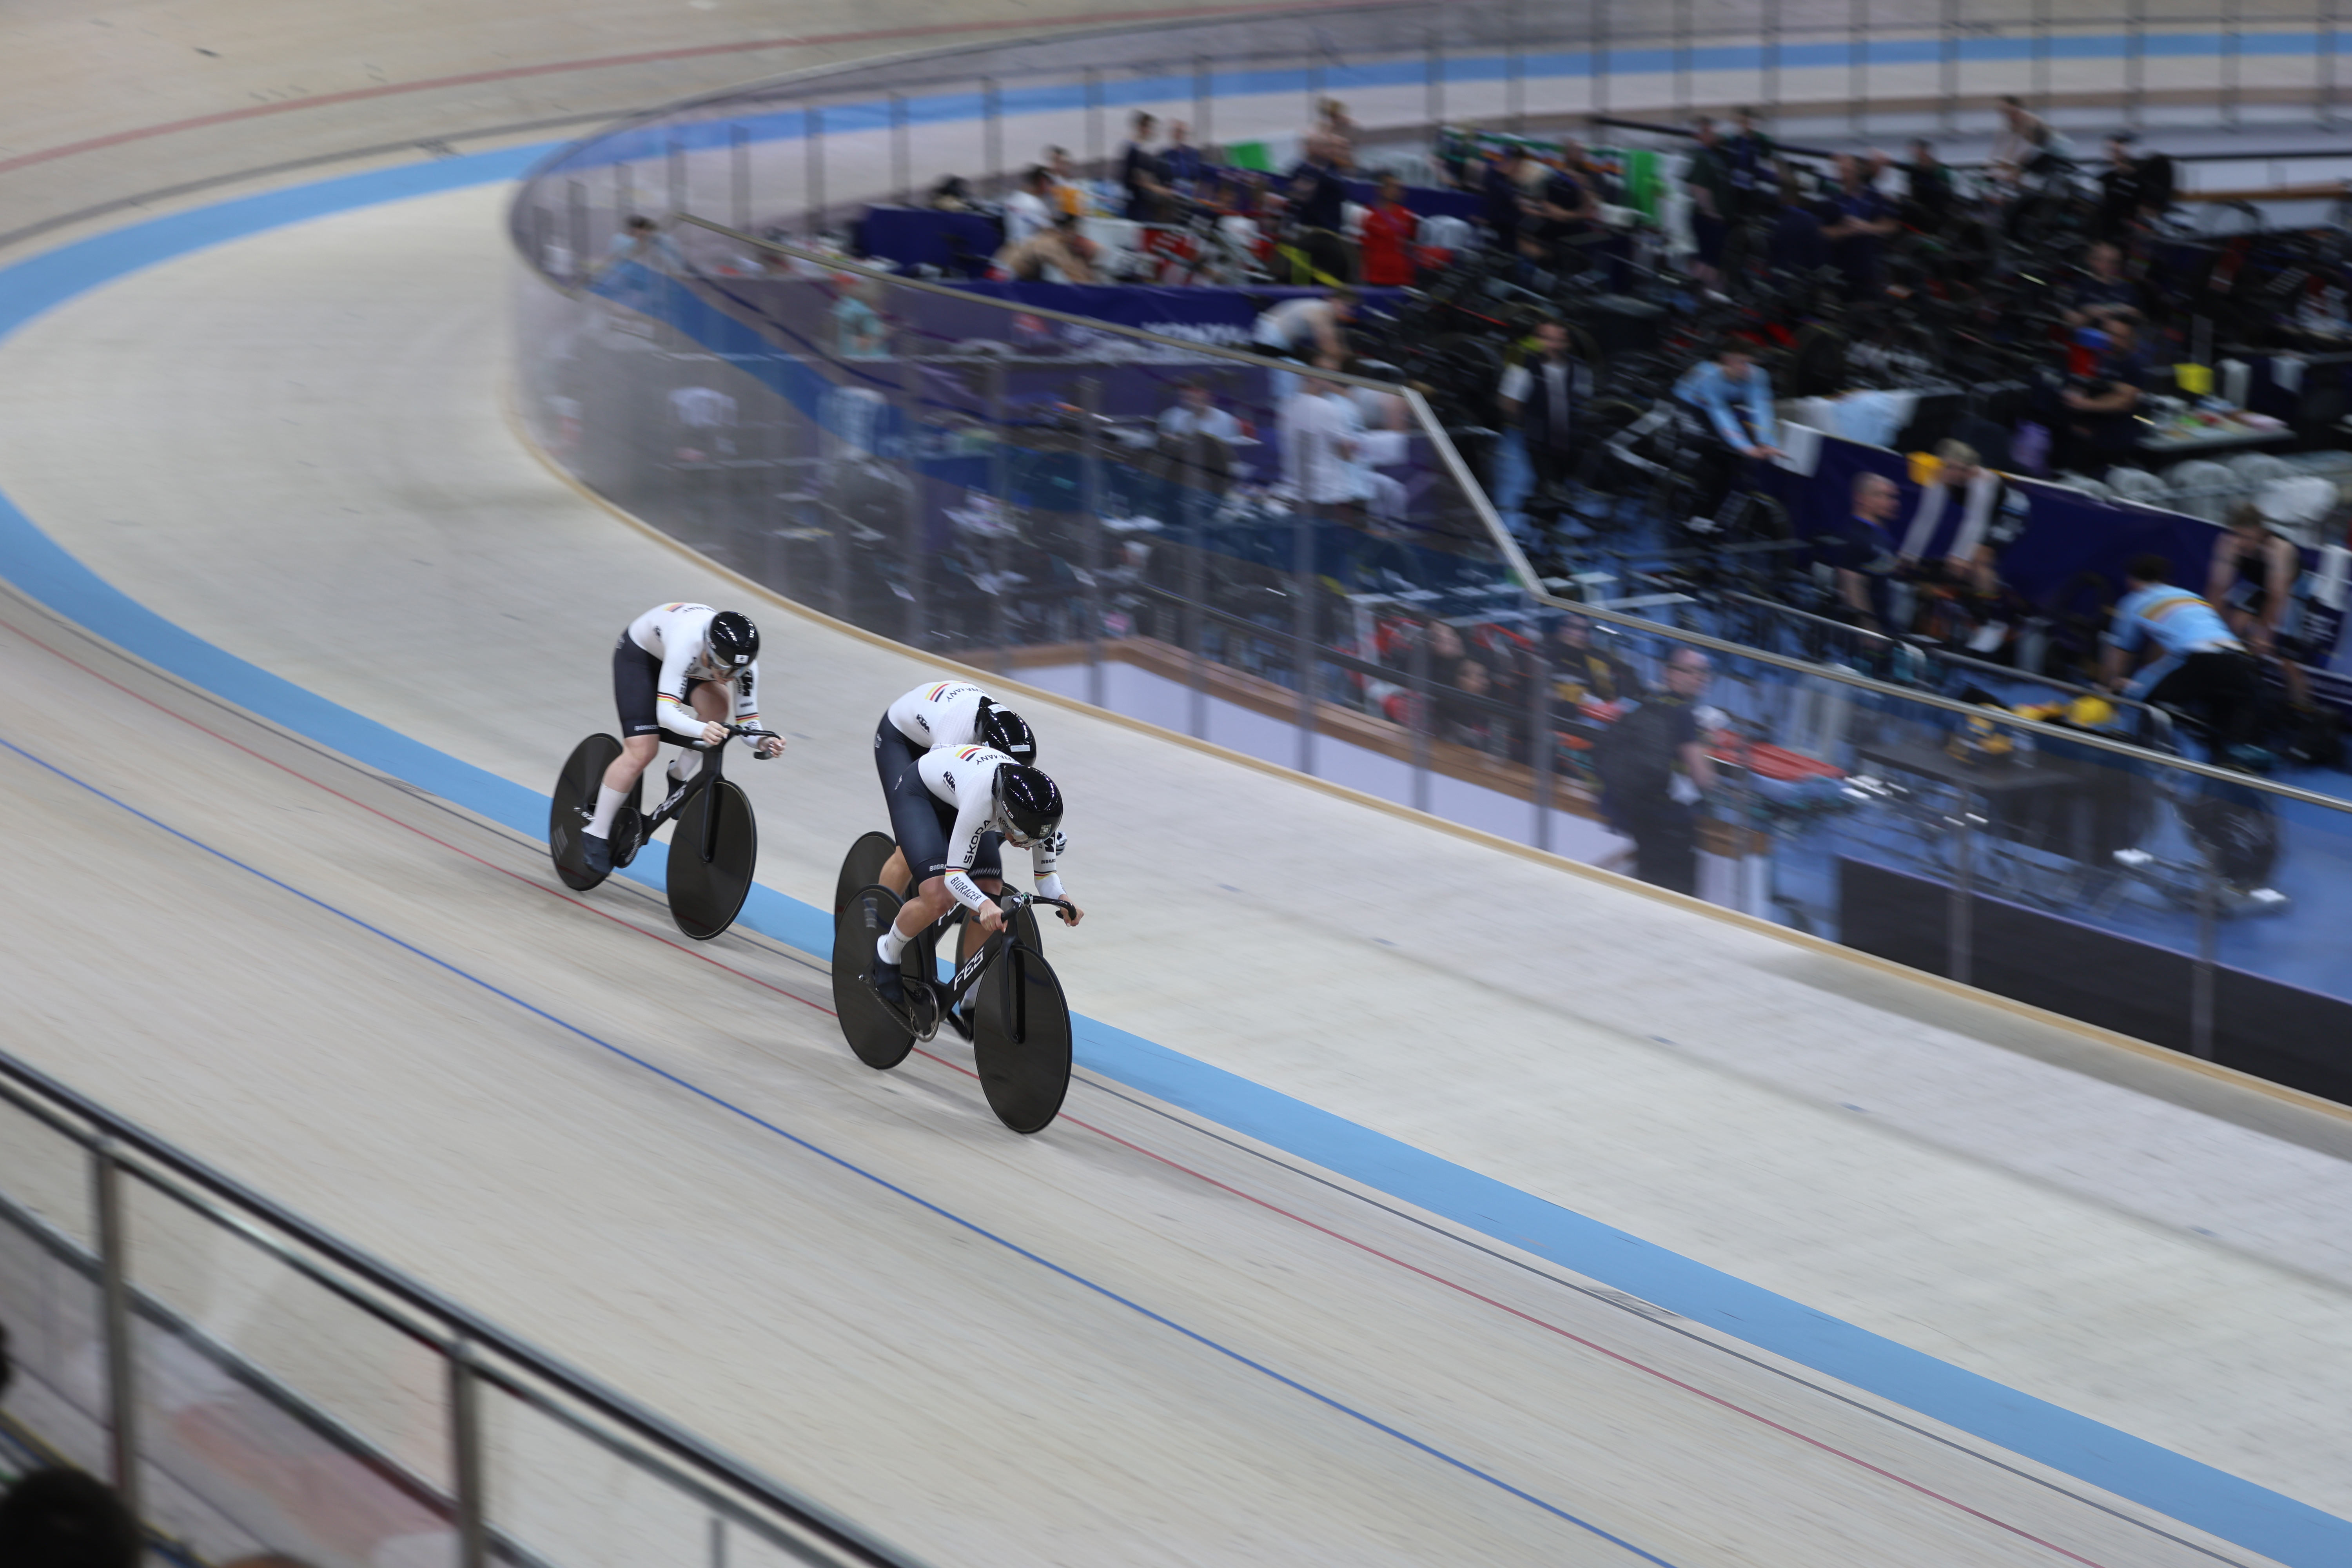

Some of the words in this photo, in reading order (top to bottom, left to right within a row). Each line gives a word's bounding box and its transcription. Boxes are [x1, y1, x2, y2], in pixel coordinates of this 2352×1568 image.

[916, 714, 930, 733] KTM
[943, 771, 955, 792] KTM
[950, 877, 982, 902] BIORACER
[954, 946, 984, 991] FES
